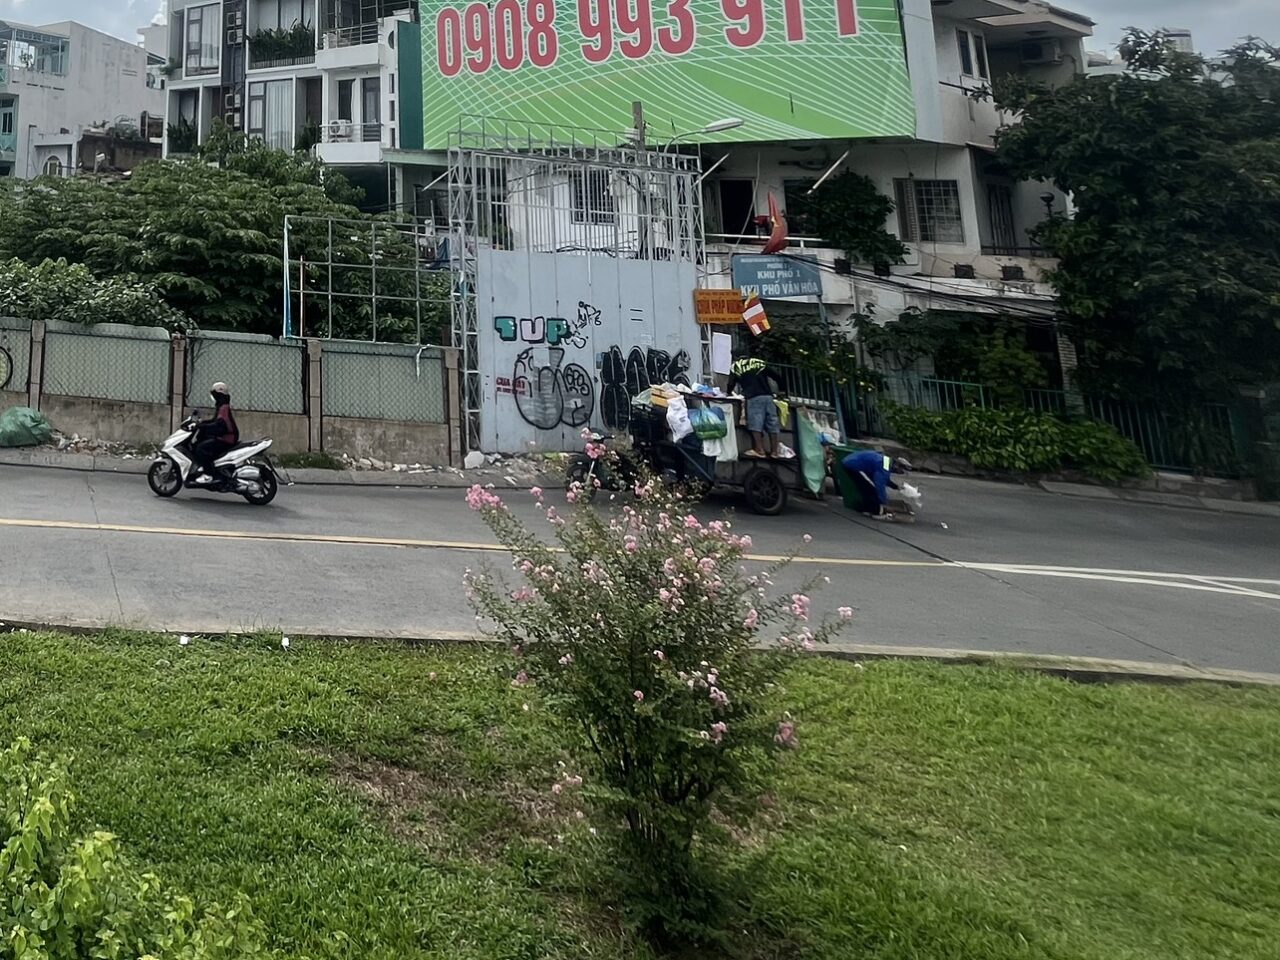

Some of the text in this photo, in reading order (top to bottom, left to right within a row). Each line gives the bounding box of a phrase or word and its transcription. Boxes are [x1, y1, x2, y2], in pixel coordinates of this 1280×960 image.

[757, 270, 775, 279] KHU
[777, 267, 793, 279] PHỐ
[762, 279, 781, 296] PHỐ
[782, 281, 800, 295] VĂN
